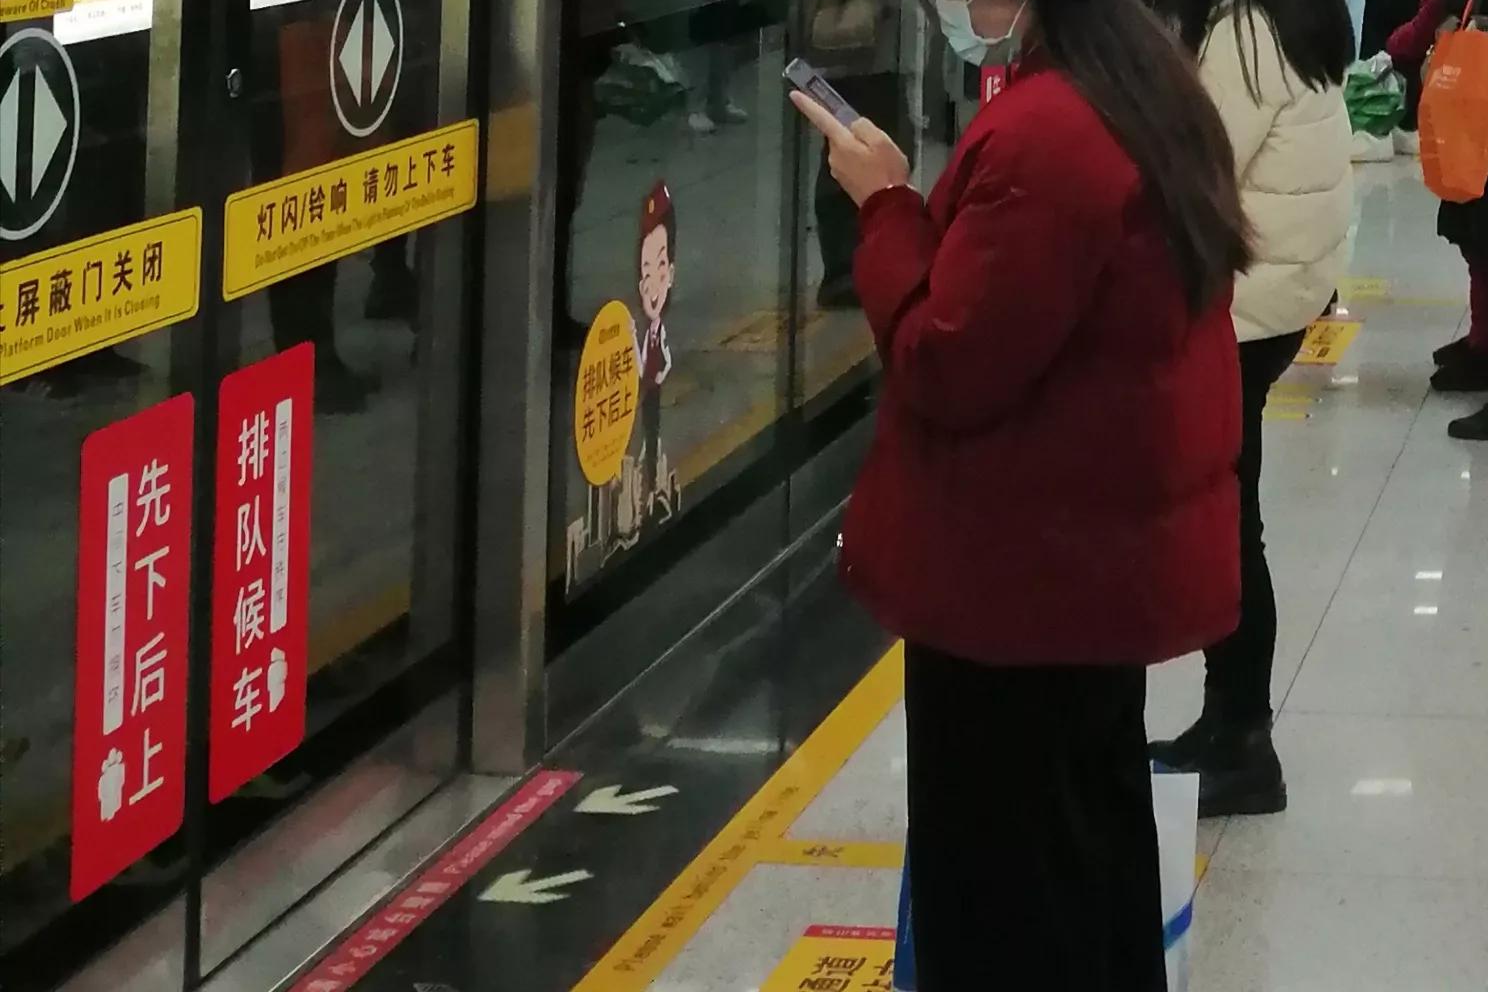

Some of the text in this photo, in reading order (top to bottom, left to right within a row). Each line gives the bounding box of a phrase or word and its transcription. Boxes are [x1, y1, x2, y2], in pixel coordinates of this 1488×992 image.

[363, 143, 456, 204] 请勿上下车
[0, 241, 163, 332] 屏蔽门关闭
[47, 325, 72, 343] Door
[582, 346, 634, 403] 排队候车
[582, 385, 633, 443] 先下后上
[231, 410, 270, 732] 排队候车
[129, 458, 171, 806] 先下后上
